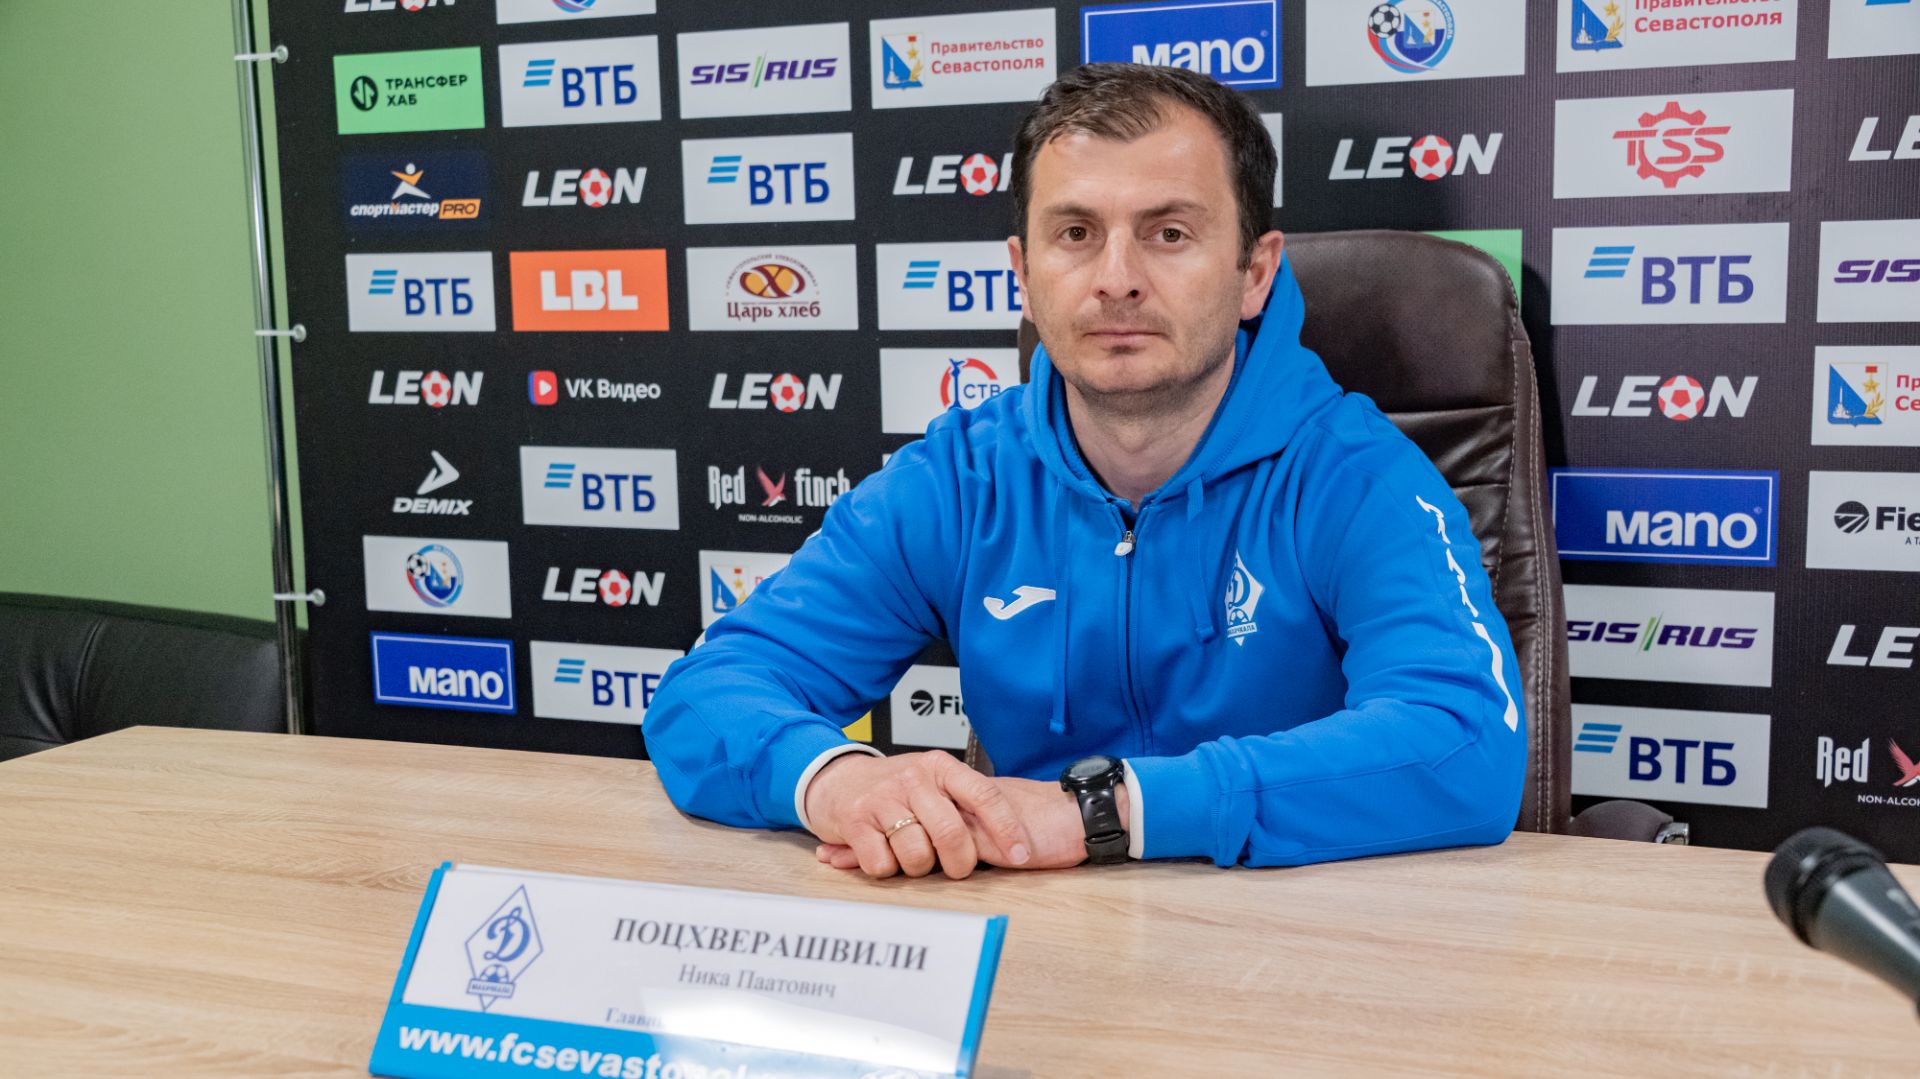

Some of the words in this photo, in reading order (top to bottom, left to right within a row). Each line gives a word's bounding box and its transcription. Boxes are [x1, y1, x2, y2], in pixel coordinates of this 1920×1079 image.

[1634, 12, 1782, 33] Севастополя
[931, 37, 1044, 55] Правительство
[385, 74, 468, 89] ТРАНСФЕР
[931, 56, 1044, 75] Севастополя
[387, 92, 417, 106] ХАБ
[562, 64, 637, 108] ВТБ
[1328, 132, 1503, 181] LEON
[522, 167, 647, 208] LEON
[749, 162, 830, 205] ВТБ
[443, 203, 476, 215] PRO
[403, 278, 473, 316] ВТБ
[540, 269, 639, 311] LBL
[1642, 254, 1754, 305] ВТБ
[727, 302, 773, 323] Царь
[778, 301, 821, 318] хлеб
[368, 370, 484, 408] LEON
[565, 378, 594, 398] VK
[597, 379, 661, 402] Видео
[708, 373, 843, 413] LEON
[1570, 375, 1759, 422] LEON
[392, 497, 473, 515] DEMIX
[581, 473, 656, 513] ВТБ
[708, 465, 746, 510] Red
[738, 514, 803, 524] NON-ALCOHOLIC
[542, 567, 666, 607] LEON
[939, 695, 964, 715] Fi
[1628, 737, 1737, 786] ВТБ
[1816, 736, 1870, 788] Red
[1857, 794, 1920, 806] NON-ALCO
[611, 917, 929, 972] ПОЦХВЕРАШВИЛИ
[678, 964, 731, 988] Ника
[736, 970, 838, 999] Паатович
